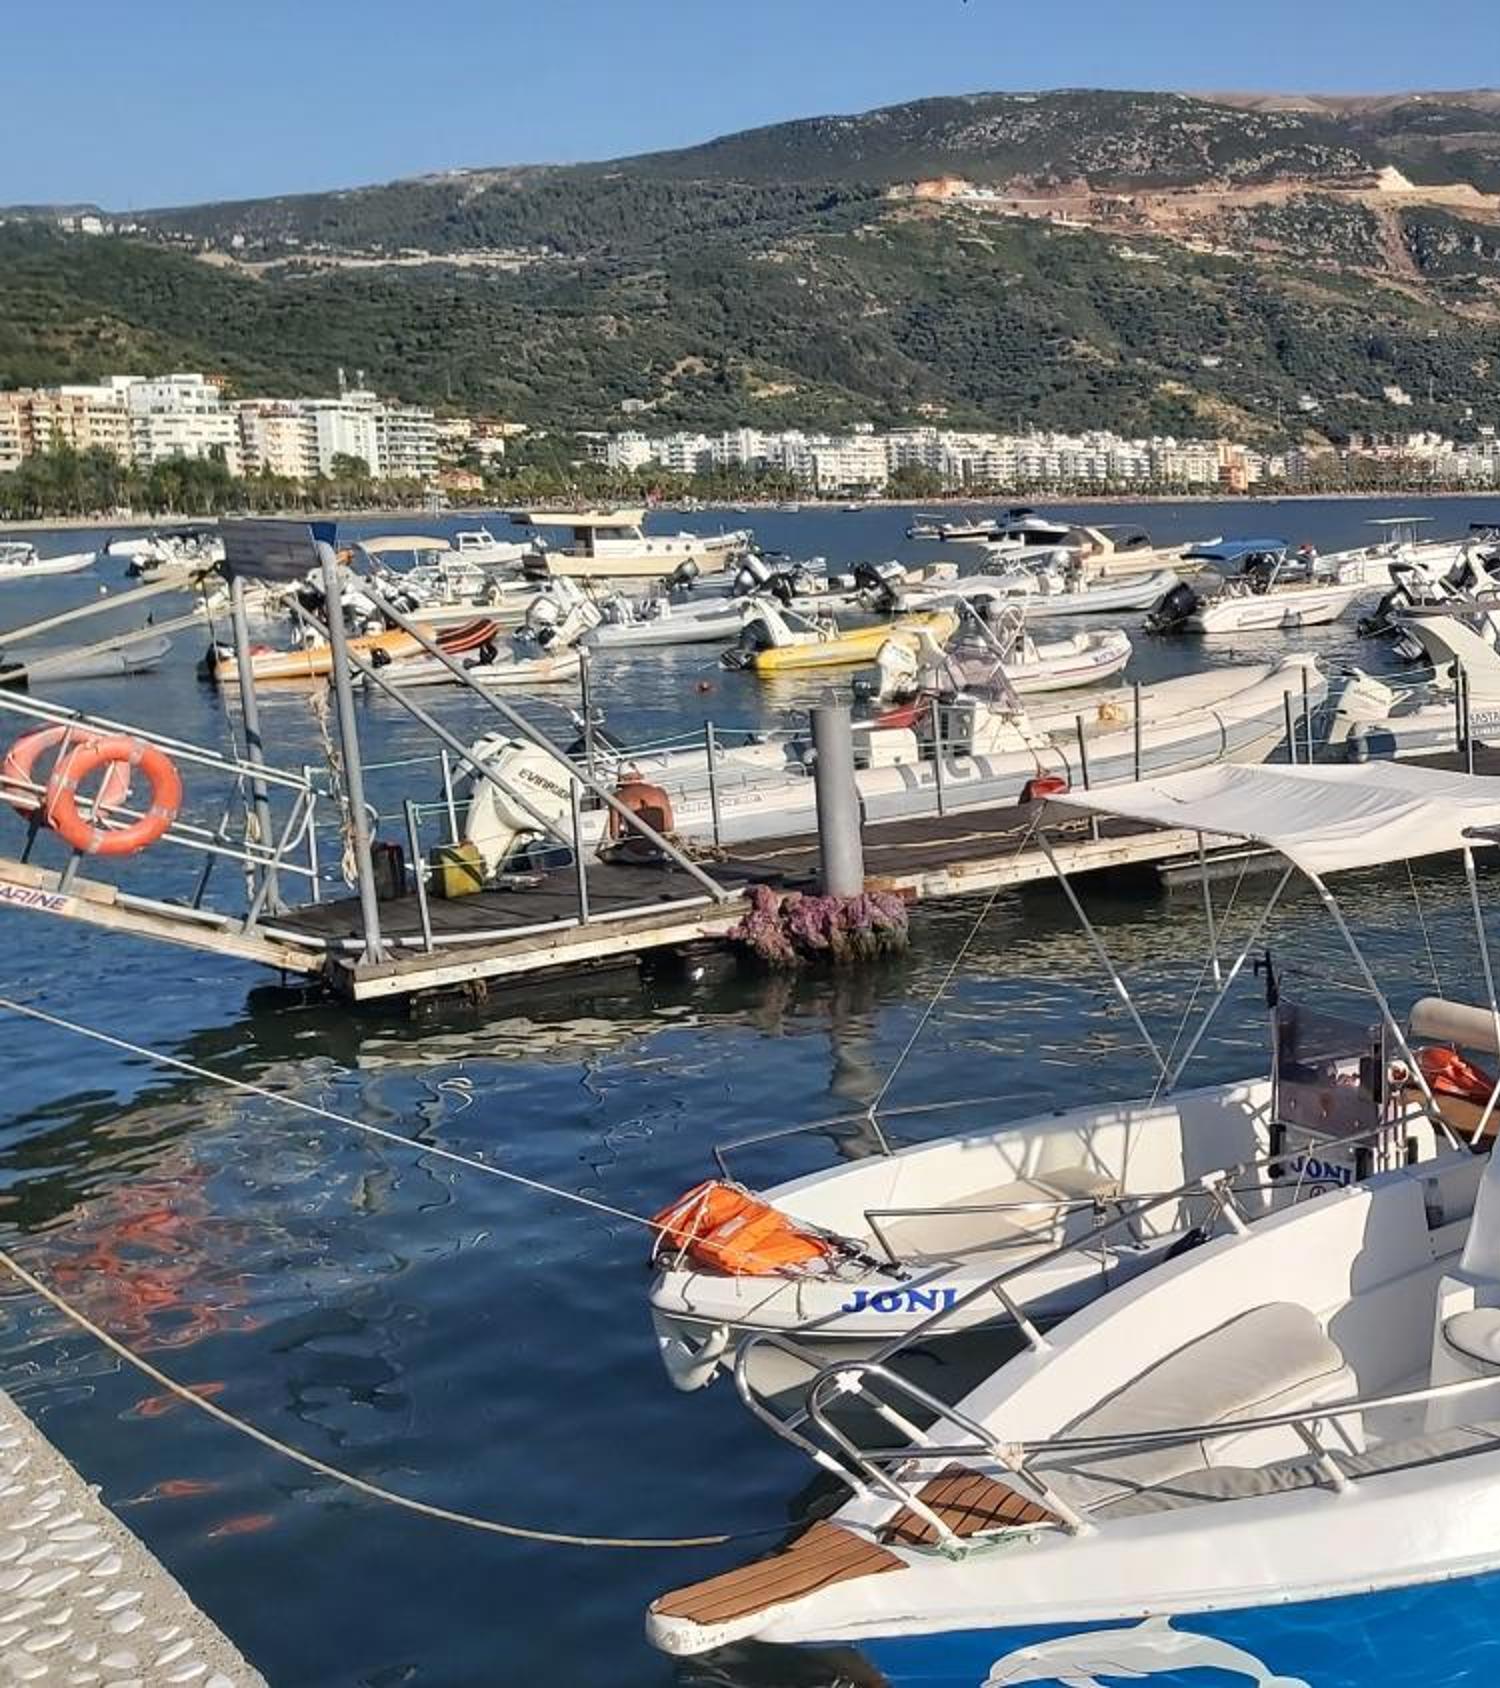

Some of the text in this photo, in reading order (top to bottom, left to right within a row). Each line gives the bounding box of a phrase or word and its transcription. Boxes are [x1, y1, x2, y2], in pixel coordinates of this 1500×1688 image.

[518, 767, 572, 800] EVINRUD
[0, 884, 66, 911] ARINE
[1290, 1155, 1352, 1188] JONI
[841, 1287, 958, 1313] JONI
